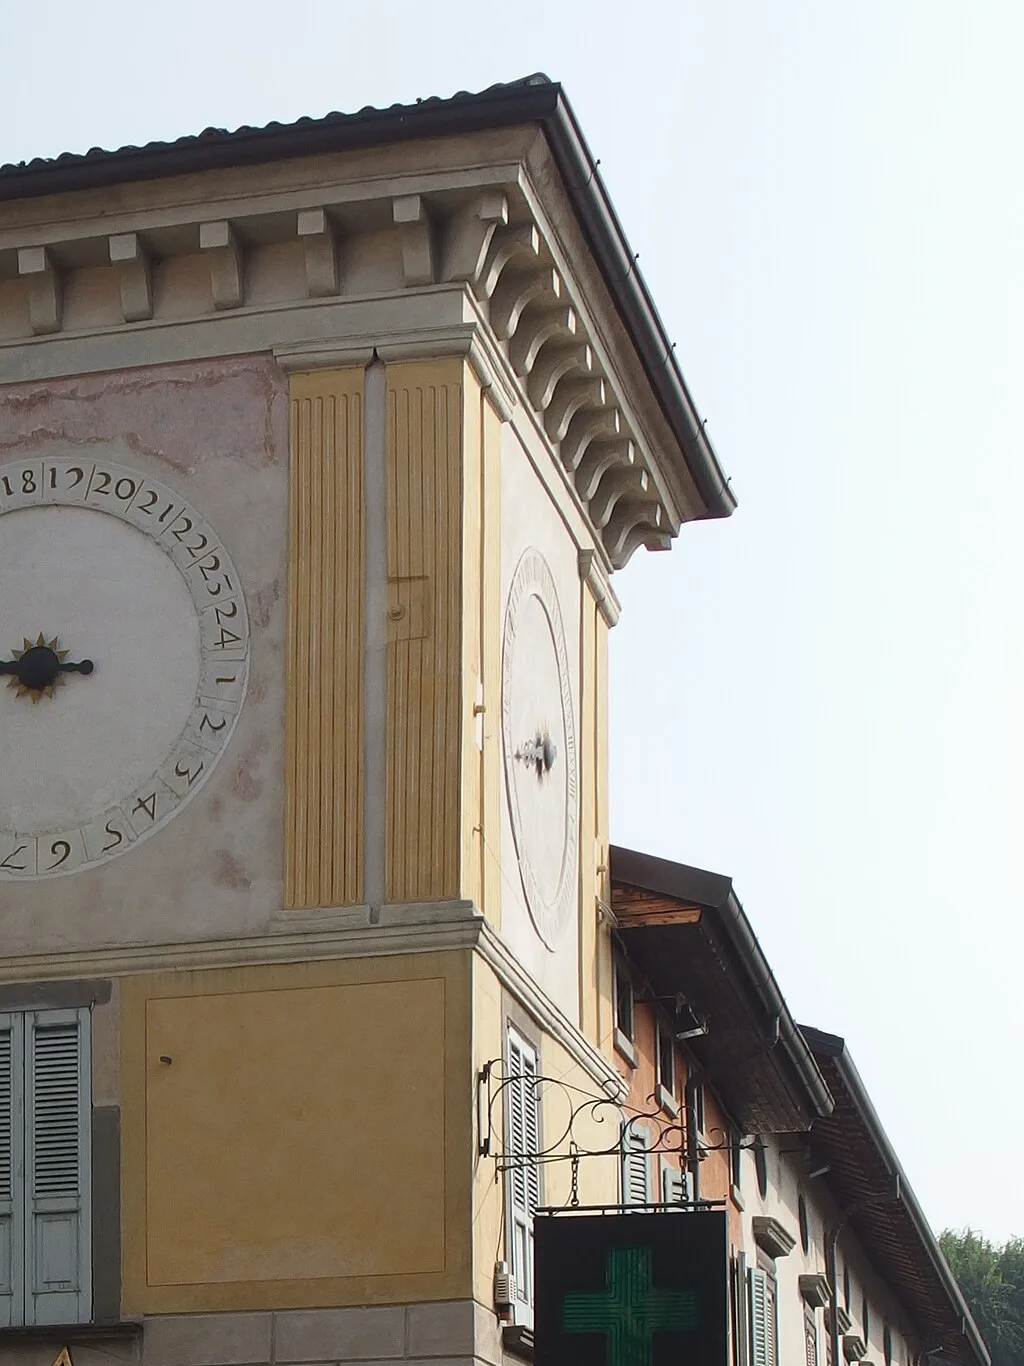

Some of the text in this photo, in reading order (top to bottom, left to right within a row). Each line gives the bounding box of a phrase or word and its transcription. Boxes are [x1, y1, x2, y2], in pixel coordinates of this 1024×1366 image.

[0, 470, 37, 496] 18
[93, 472, 135, 500] 20
[137, 490, 175, 522] 21
[170, 517, 209, 560] 22
[196, 556, 233, 597] 23
[213, 602, 242, 648] 24
[214, 676, 236, 686] 1
[198, 713, 226, 734] 2
[174, 760, 204, 788] 3
[132, 792, 157, 822] 4
[101, 820, 123, 853] 5
[0, 845, 28, 871] 7
[45, 840, 71, 871] 6
